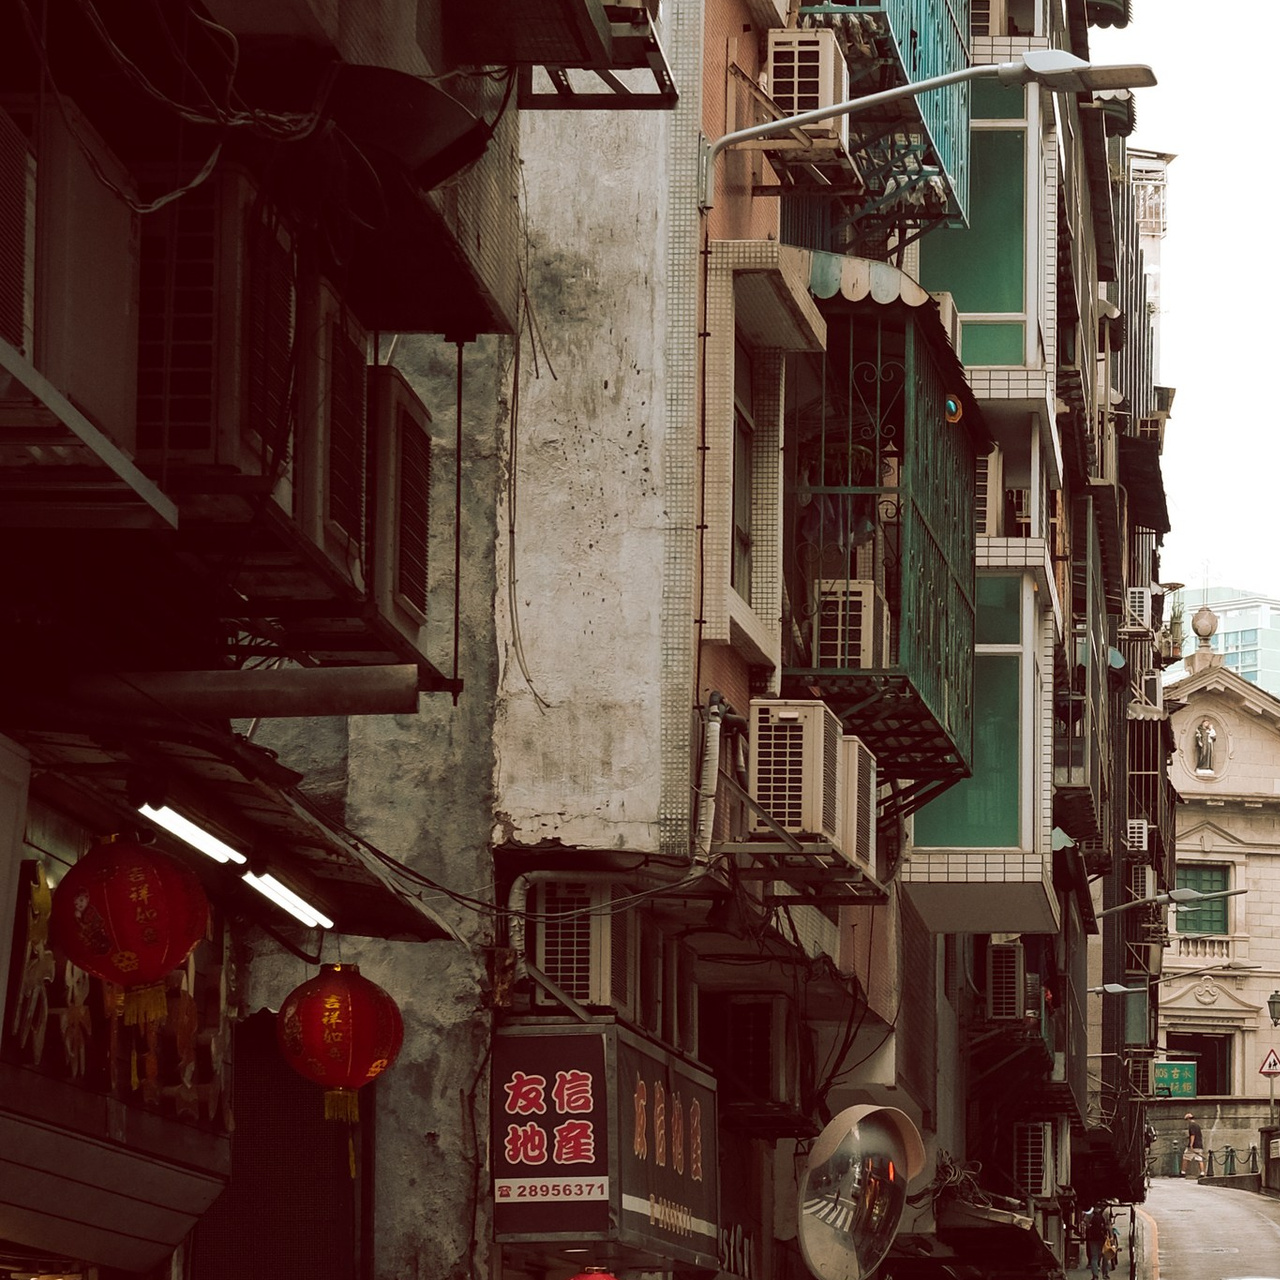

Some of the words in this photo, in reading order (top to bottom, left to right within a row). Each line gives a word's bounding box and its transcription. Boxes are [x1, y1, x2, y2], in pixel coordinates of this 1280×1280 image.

[504, 1069, 594, 1115] 友信
[504, 1119, 596, 1166] 地產
[517, 1183, 606, 1198] 28956371
